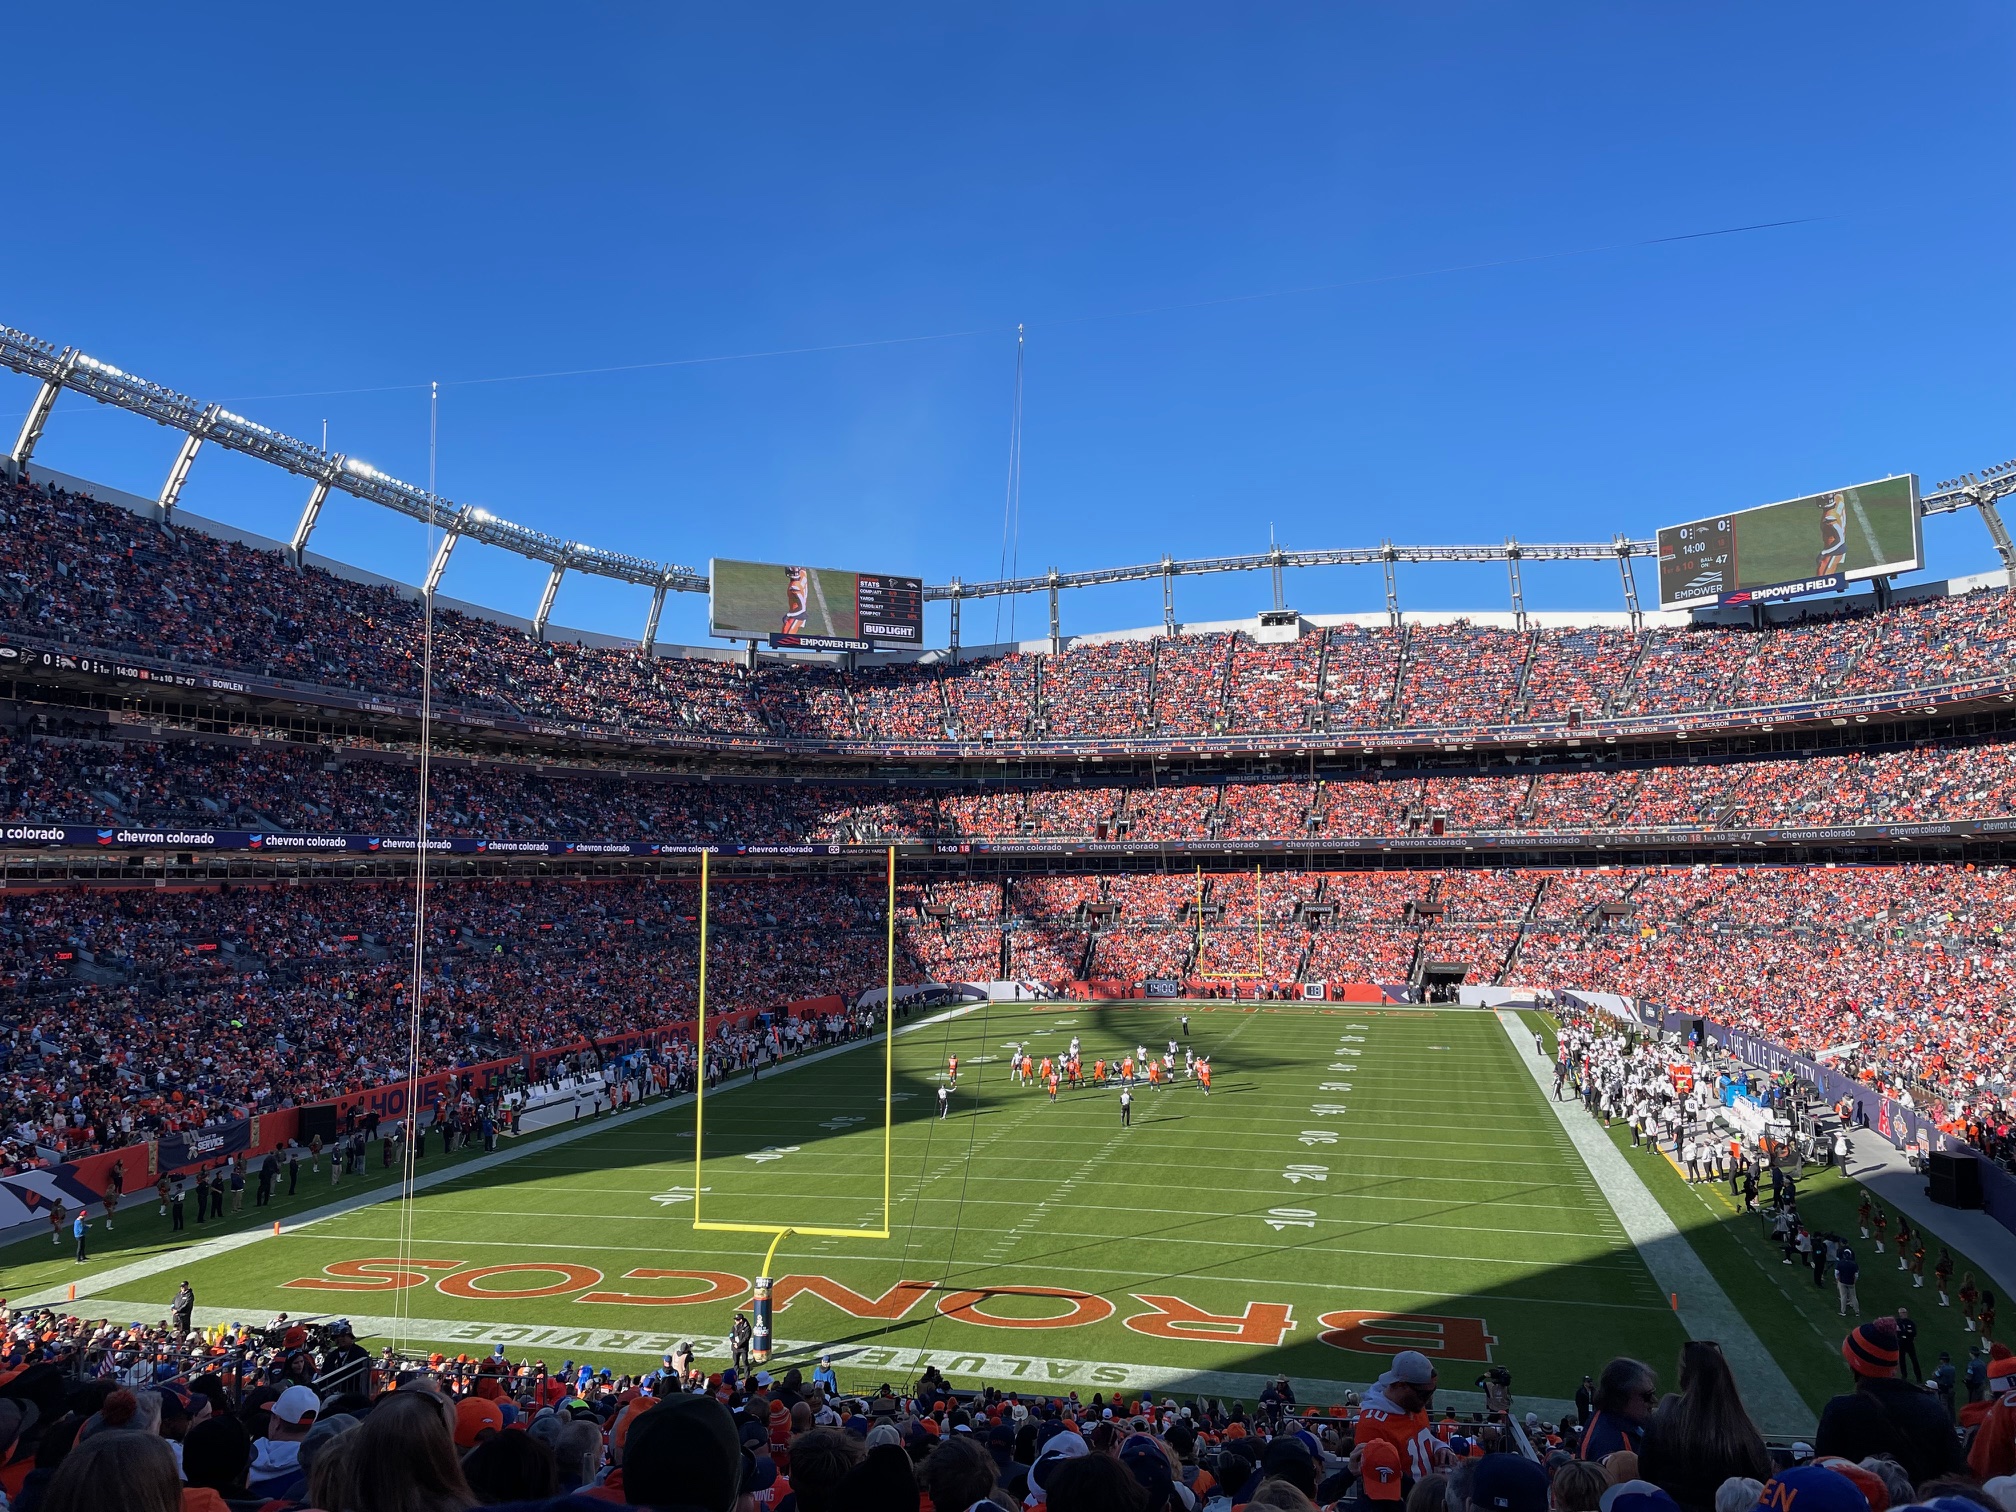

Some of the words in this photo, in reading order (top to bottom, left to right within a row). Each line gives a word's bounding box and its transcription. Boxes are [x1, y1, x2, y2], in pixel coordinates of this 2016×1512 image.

[1718, 520, 1726, 531] 0
[1680, 529, 1688, 539] 0
[1683, 542, 1705, 555] 14:00
[1715, 554, 1728, 564] 47
[1675, 584, 1723, 599] EMPOWER
[1751, 583, 1804, 600] EMPOWER
[1806, 578, 1837, 591] FIELD
[865, 625, 885, 634] BUD
[886, 626, 913, 636] LIGHT
[800, 638, 843, 649] EMPOWER
[845, 640, 869, 650] FIELD
[43, 653, 51, 665] 0
[82, 660, 89, 671] 0
[117, 666, 138, 678] 14:00
[185, 678, 196, 687] 47
[212, 680, 243, 691] BOWLEN
[1832, 706, 1871, 716] ZIMMERMAN
[1630, 726, 1658, 734] MORTON
[1700, 721, 1729, 729] JACKSON
[1889, 826, 1919, 835] chevron
[1921, 824, 1950, 834] colorado
[1982, 821, 2008, 831] chevron
[7, 826, 65, 840] colorado
[117, 830, 164, 843] chevron
[166, 831, 215, 844] colorado
[1717, 833, 1725, 841] 10
[1740, 833, 1752, 841] 47
[1781, 830, 1817, 839] chevron
[1820, 829, 1856, 838] colorado
[266, 835, 304, 847] chevron
[306, 836, 347, 848] colorado
[382, 838, 415, 849] chevron
[417, 839, 452, 849] colorado
[1286, 840, 1320, 848] chevron
[1322, 839, 1360, 848] colorado
[1390, 838, 1425, 847] chevron
[1427, 838, 1467, 846] colorado
[1500, 837, 1537, 845] chevron
[1538, 836, 1580, 844] colorado
[1666, 834, 1687, 843] 14:00
[1690, 834, 1701, 842] 18
[488, 841, 517, 851] chevron
[518, 842, 549, 851] colorado
[576, 843, 602, 852] chevron
[603, 843, 630, 852] colorado
[661, 845, 687, 853] chevron
[748, 845, 779, 853] chevron
[780, 845, 813, 853] colorado
[938, 845, 957, 853] 14:00
[992, 844, 1025, 852] chevron
[1123, 842, 1159, 850] colorado
[1188, 841, 1221, 849] chevron
[1223, 841, 1260, 849] colorado
[1097, 986, 1117, 994] THIS
[1149, 983, 1175, 993] 14:00
[1309, 986, 1320, 996] 18
[1730, 1034, 1744, 1060] THE
[1747, 1040, 1768, 1069] MILE
[371, 1081, 438, 1117] HOME
[1298, 1131, 1339, 1143] 30
[197, 1136, 224, 1150] SERVICE
[1282, 1164, 1330, 1181] 20
[1264, 1208, 1318, 1229] 10
[276, 1257, 1499, 1364] BRONCOS
[449, 1324, 723, 1353] SERVICE
[857, 1349, 1131, 1384] SALUTE
